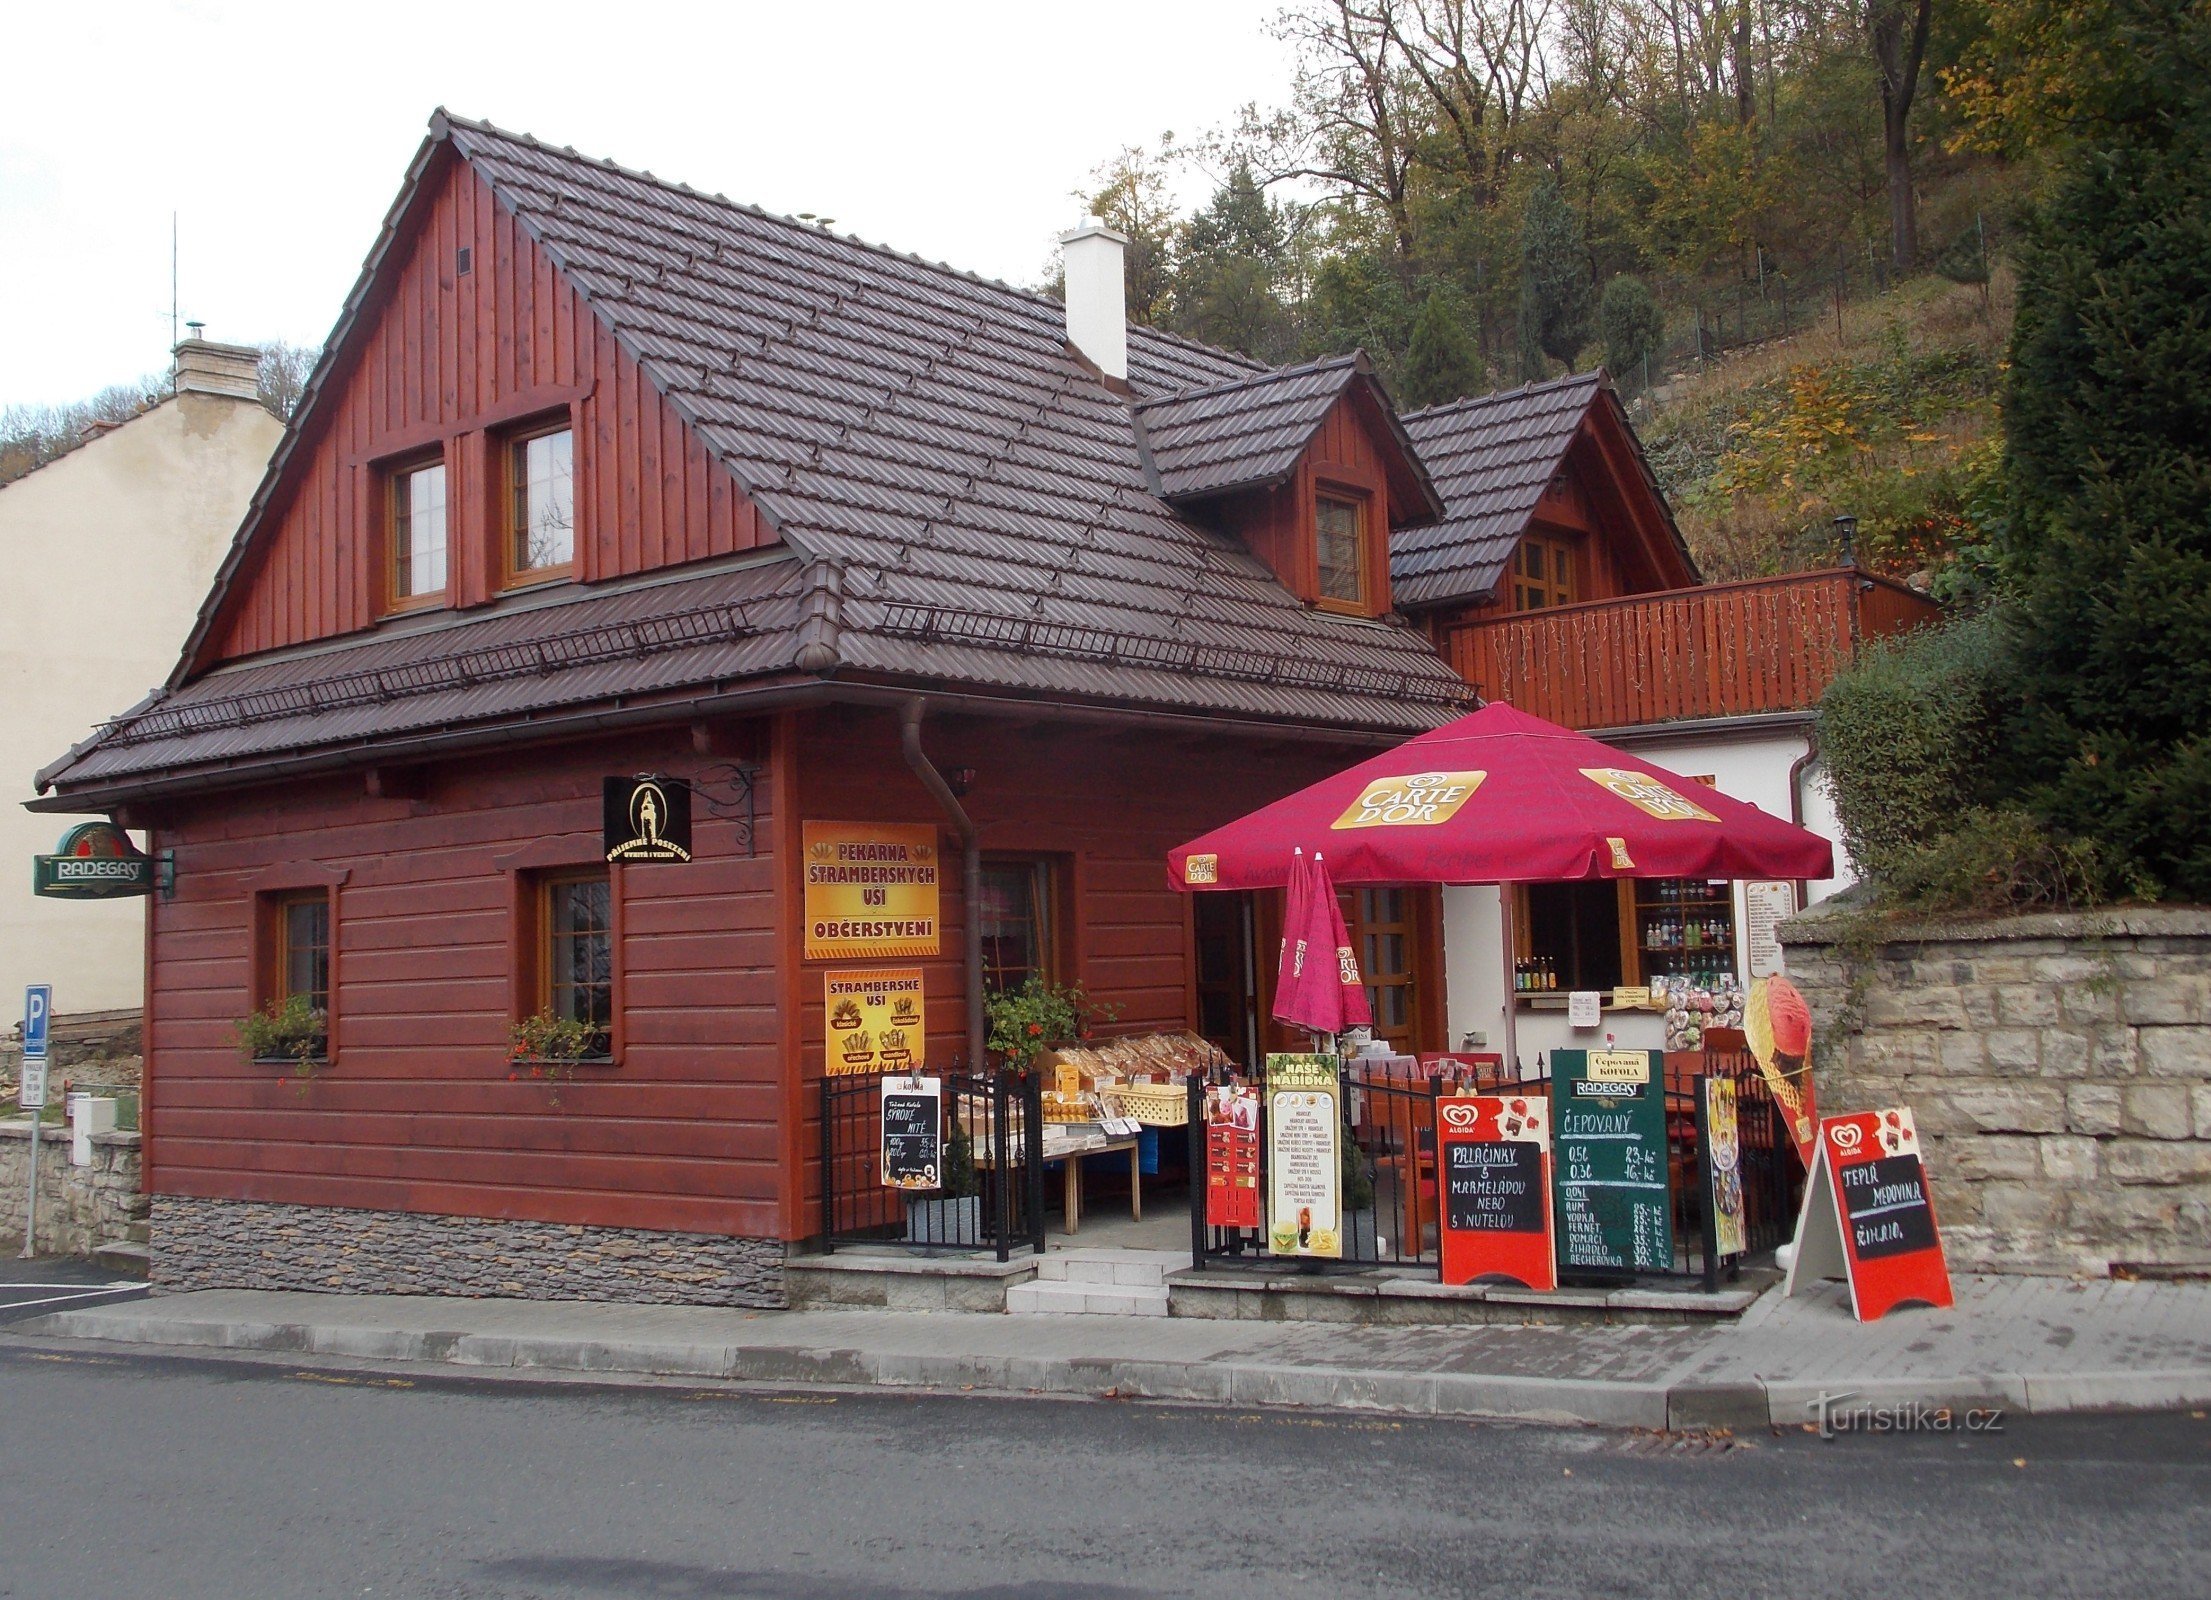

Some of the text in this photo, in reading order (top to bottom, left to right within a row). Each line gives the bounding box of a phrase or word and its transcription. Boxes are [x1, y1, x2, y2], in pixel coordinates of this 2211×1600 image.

[1361, 786, 1466, 808] CARTE
[1607, 782, 1684, 801] CARTE
[1354, 803, 1438, 823] D'OR
[837, 840, 908, 861] PEKÁRNA
[57, 861, 142, 880] RADEGAST
[809, 863, 935, 884] ŠTRAMBERSKÝCH
[1188, 862, 1215, 873] CARTE
[1190, 872, 1213, 882] D'OR
[814, 918, 933, 938] OBČERSTVENÍ
[29, 994, 44, 1033] P
[1285, 1062, 1319, 1074] NAŠE
[1595, 1056, 1639, 1067] Čepovaná
[1272, 1074, 1333, 1086] NABÍDKA
[1600, 1068, 1639, 1076] KOFOLA
[1577, 1082, 1639, 1097] RADEGAST
[1564, 1109, 1633, 1133] ČEPOVANÝ
[1453, 1143, 1517, 1163] PALAČINKY
[1840, 1148, 1862, 1156] ALGIDA
[1842, 1162, 1879, 1188] TEPLÁ
[1452, 1176, 1525, 1194] MARMELÁDOU
[1872, 1181, 1921, 1207] MEDOVINA
[1477, 1197, 1505, 1210] NEBO
[1565, 1202, 1585, 1212] RUM
[1566, 1212, 1595, 1223] VODKA
[1570, 1254, 1623, 1267] BECHEROVKA
